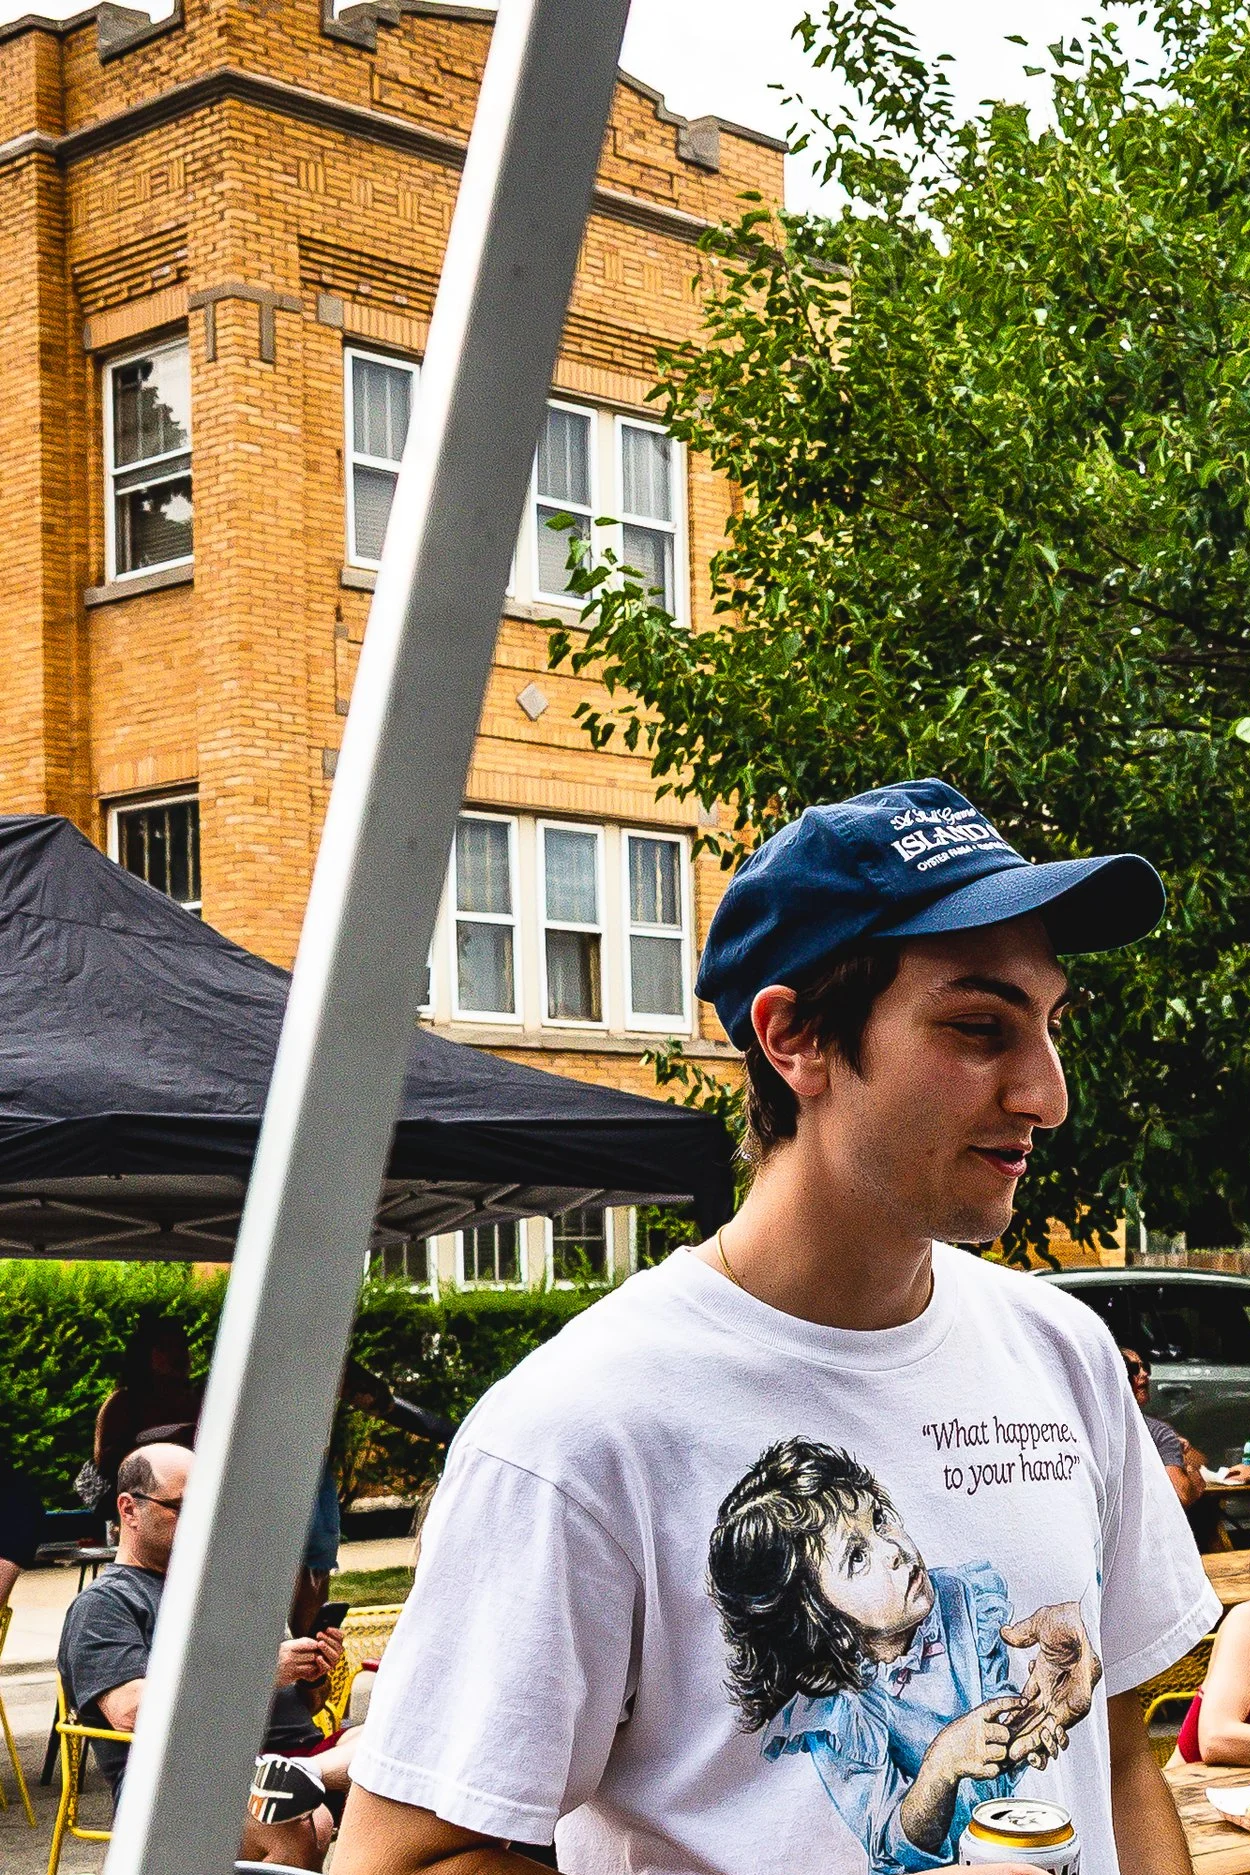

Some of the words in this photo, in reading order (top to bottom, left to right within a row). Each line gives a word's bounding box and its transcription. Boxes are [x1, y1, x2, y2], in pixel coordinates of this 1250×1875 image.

[891, 822, 990, 862] ISLAND
[917, 850, 951, 871] OYSTER
[943, 1464, 964, 1491] to
[967, 1460, 1016, 1496] your
